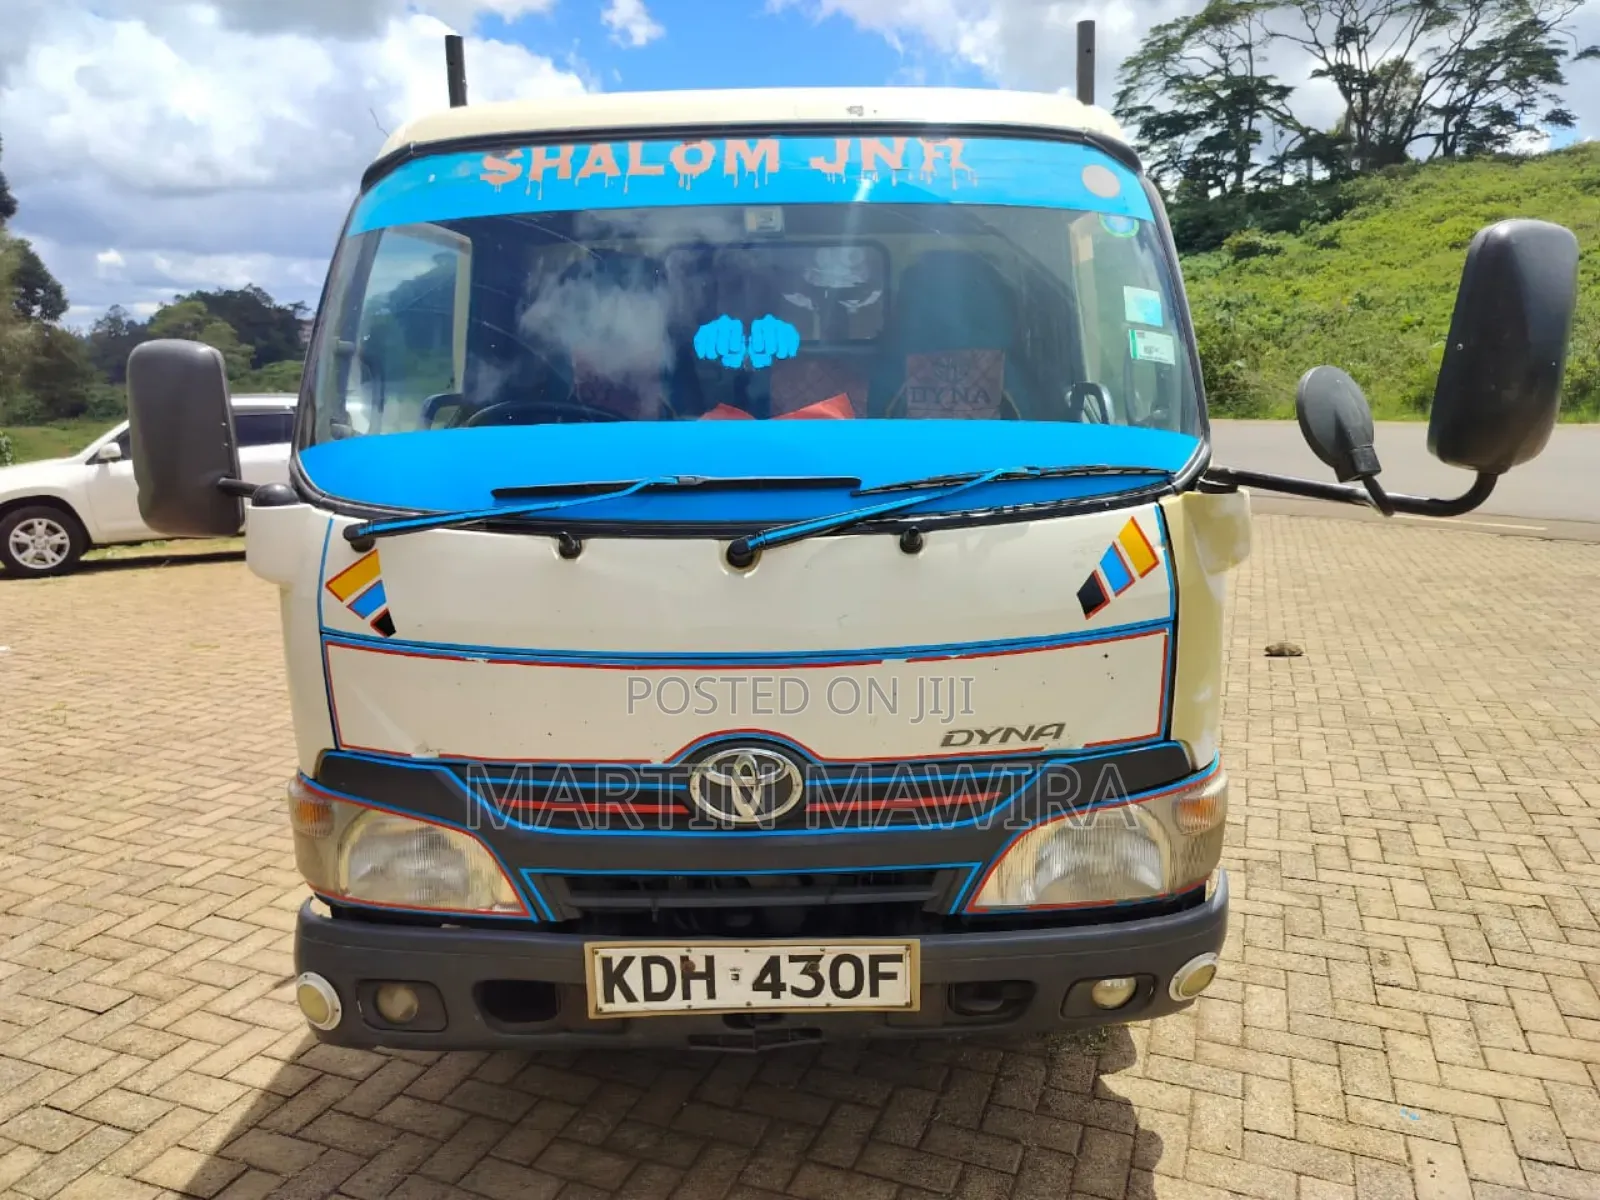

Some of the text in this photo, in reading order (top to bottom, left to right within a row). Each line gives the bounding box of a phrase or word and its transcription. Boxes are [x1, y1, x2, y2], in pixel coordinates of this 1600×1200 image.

[479, 136, 976, 196] SHALOM JNR
[940, 722, 1067, 748] DYNA
[601, 952, 904, 1004] KDH 430F
